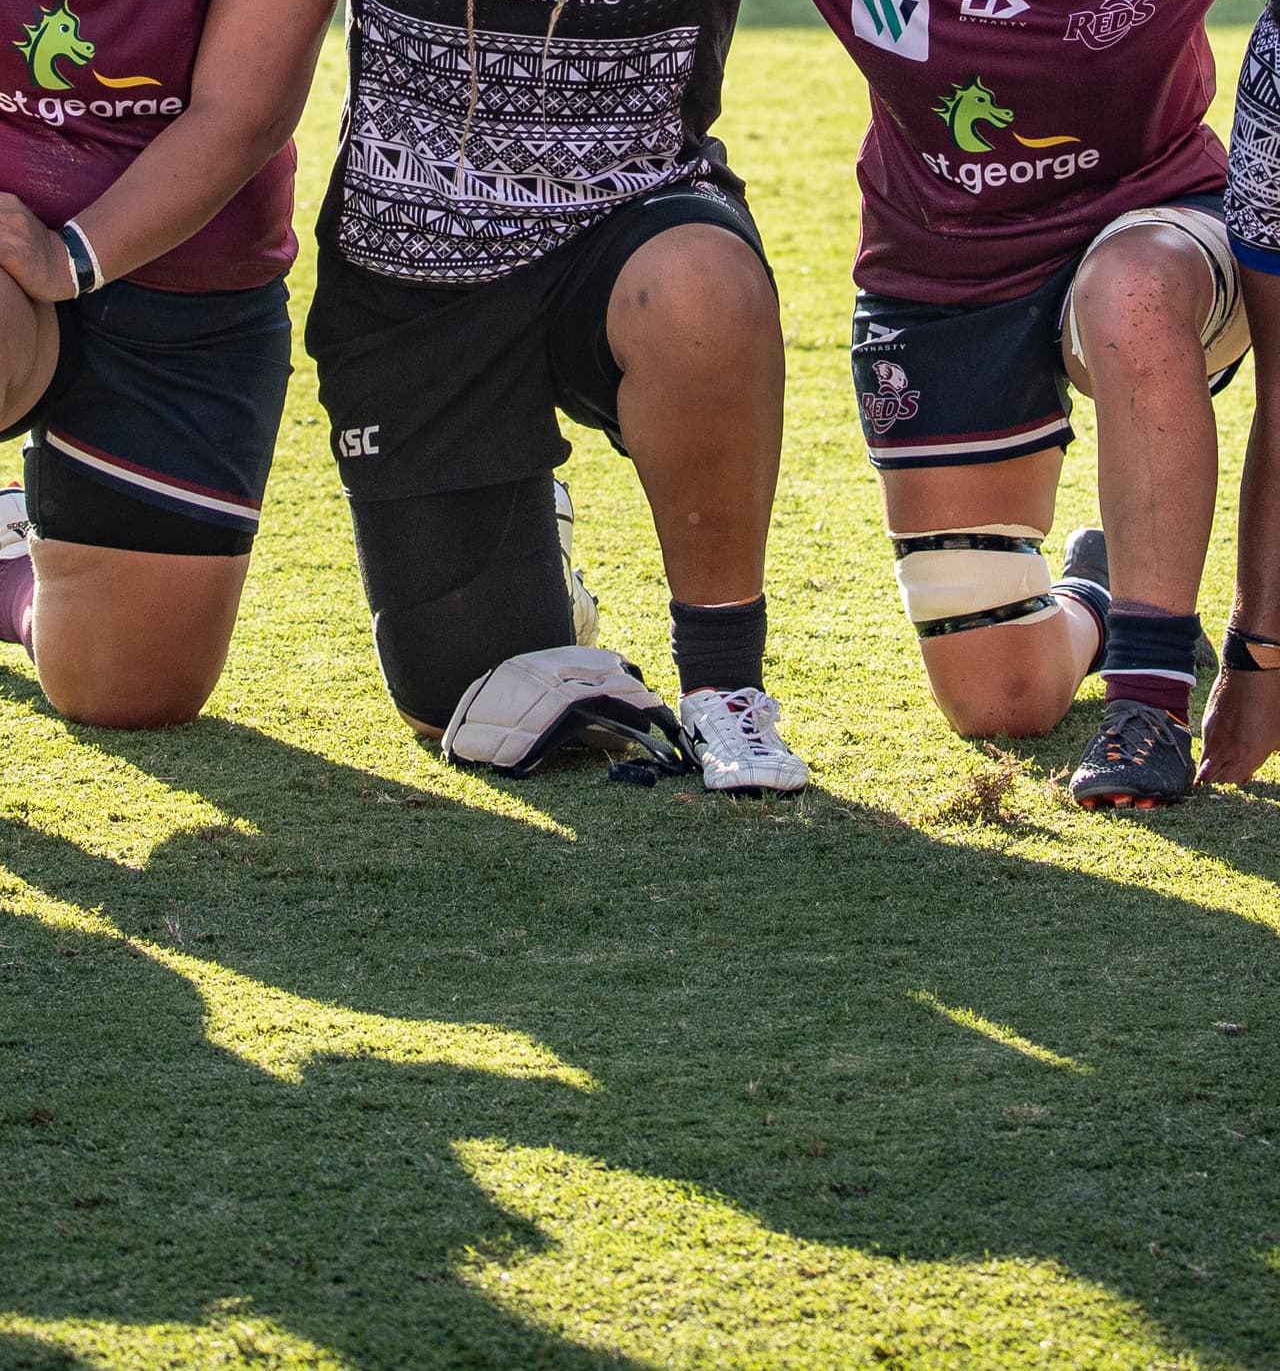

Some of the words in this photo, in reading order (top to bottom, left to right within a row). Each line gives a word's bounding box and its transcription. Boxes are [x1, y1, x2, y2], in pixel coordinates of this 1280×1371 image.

[959, 15, 1027, 28] DYNASTY
[922, 148, 1100, 195] st.george
[862, 390, 921, 435] REDS
[339, 425, 380, 458] ISC
